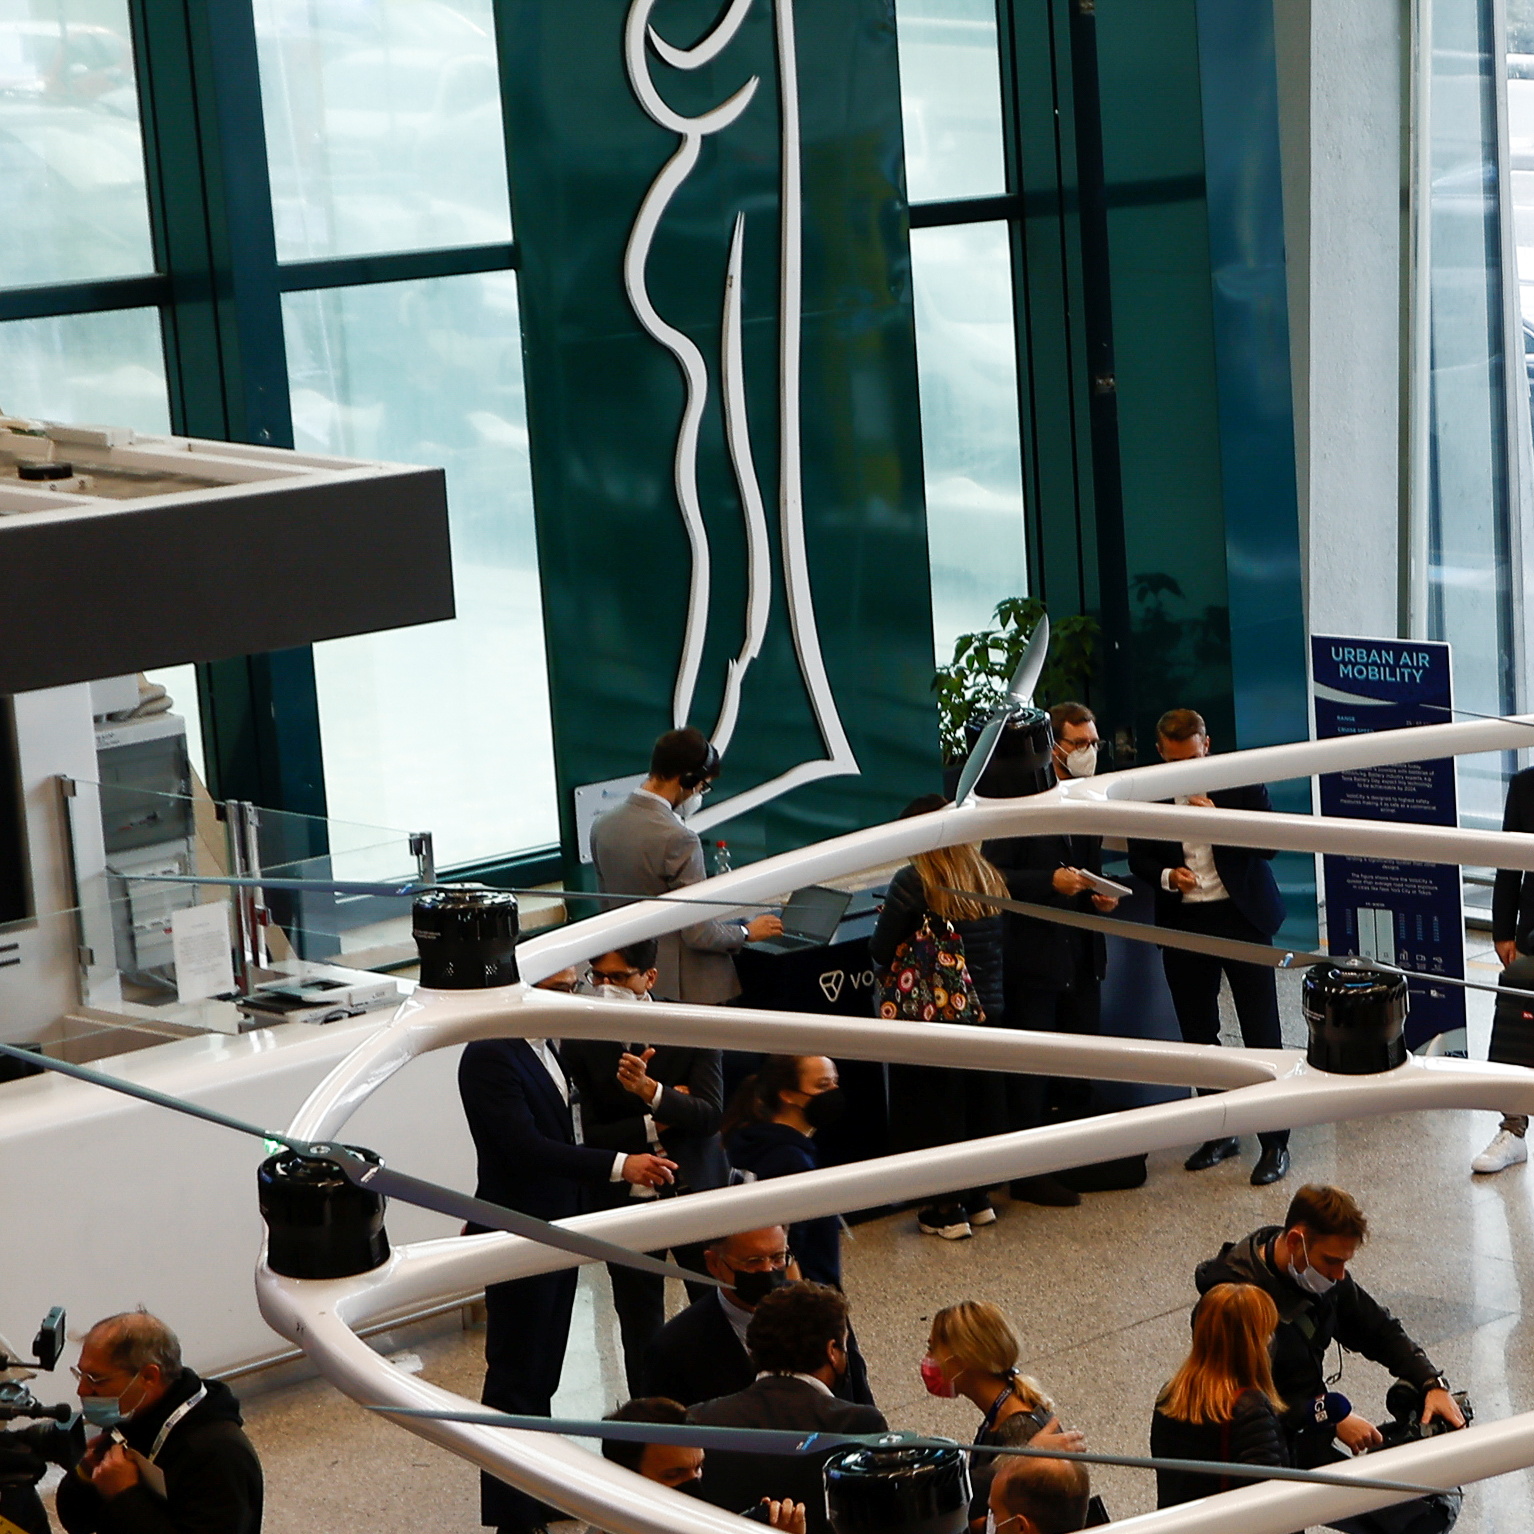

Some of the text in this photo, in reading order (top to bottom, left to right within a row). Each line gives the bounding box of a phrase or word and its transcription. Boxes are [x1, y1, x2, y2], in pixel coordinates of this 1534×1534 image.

[1331, 646, 1430, 667] URBAN AIR
[1339, 664, 1423, 683] MOBILITY
